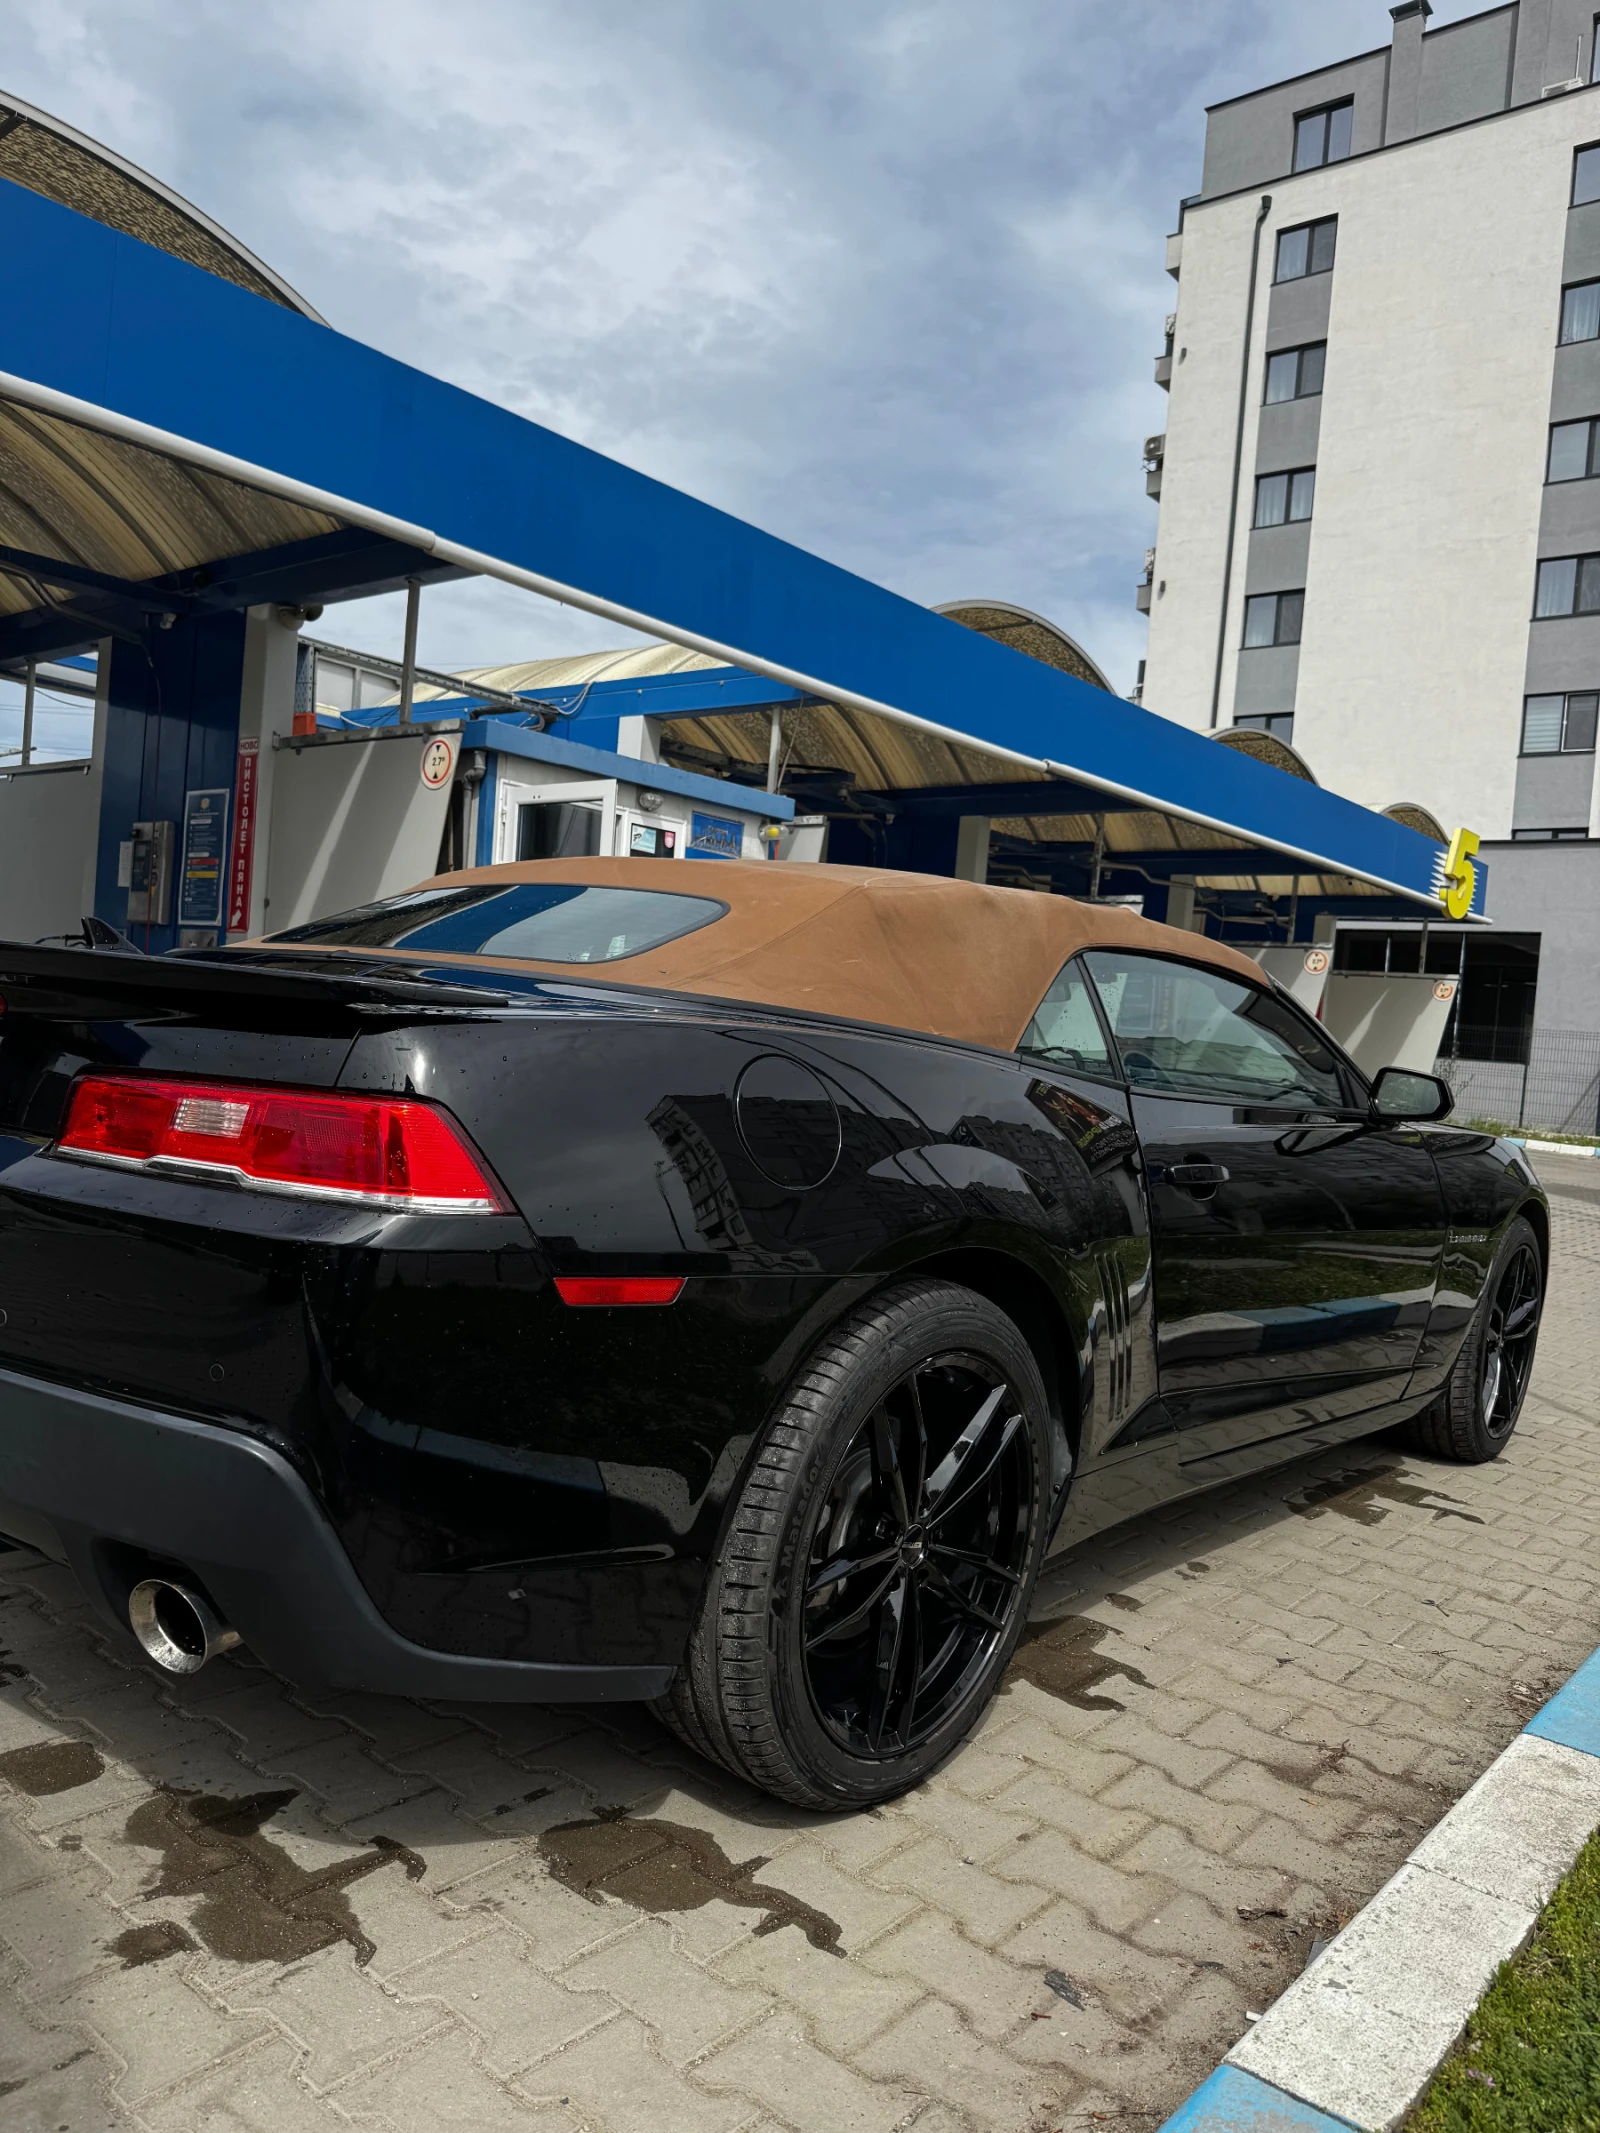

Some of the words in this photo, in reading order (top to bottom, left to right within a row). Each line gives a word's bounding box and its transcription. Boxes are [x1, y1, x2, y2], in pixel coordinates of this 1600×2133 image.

[240, 757, 251, 854] ПИСТОЛЕТ
[236, 859, 245, 908] ПЯНА
[1438, 827, 1481, 921] 5
[779, 1452, 823, 1568] Matador
